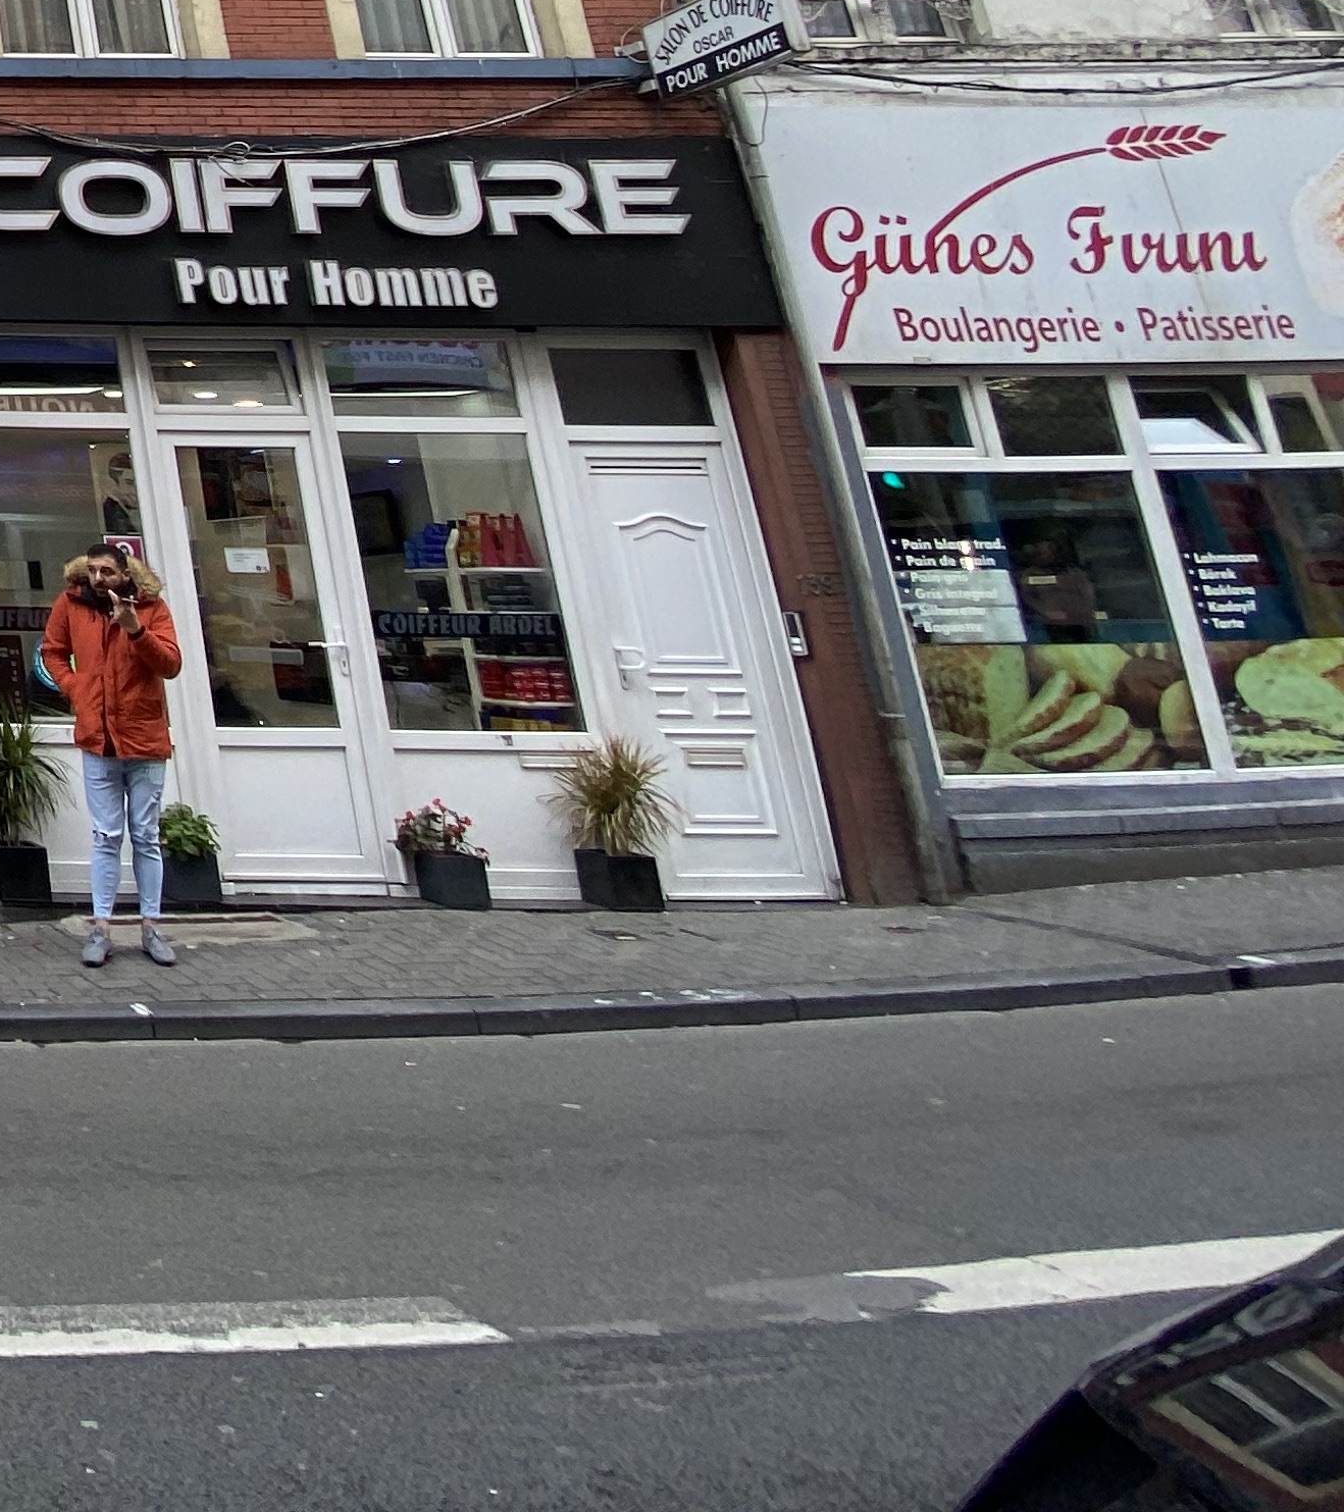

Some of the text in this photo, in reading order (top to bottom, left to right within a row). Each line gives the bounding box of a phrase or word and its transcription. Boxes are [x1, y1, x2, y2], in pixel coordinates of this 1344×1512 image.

[655, 18, 690, 65] SALON
[687, 4, 708, 28] DE
[693, 26, 734, 54] OSCAR
[666, 31, 781, 93] POUR HOMME
[174, 257, 499, 309] Pour Homme
[893, 305, 1295, 353] Boulangerie Patisserie
[901, 538, 932, 550] Pain
[905, 555, 937, 567] Pain
[939, 555, 956, 567] de
[377, 613, 556, 636] COIFFEUR ABDEL
